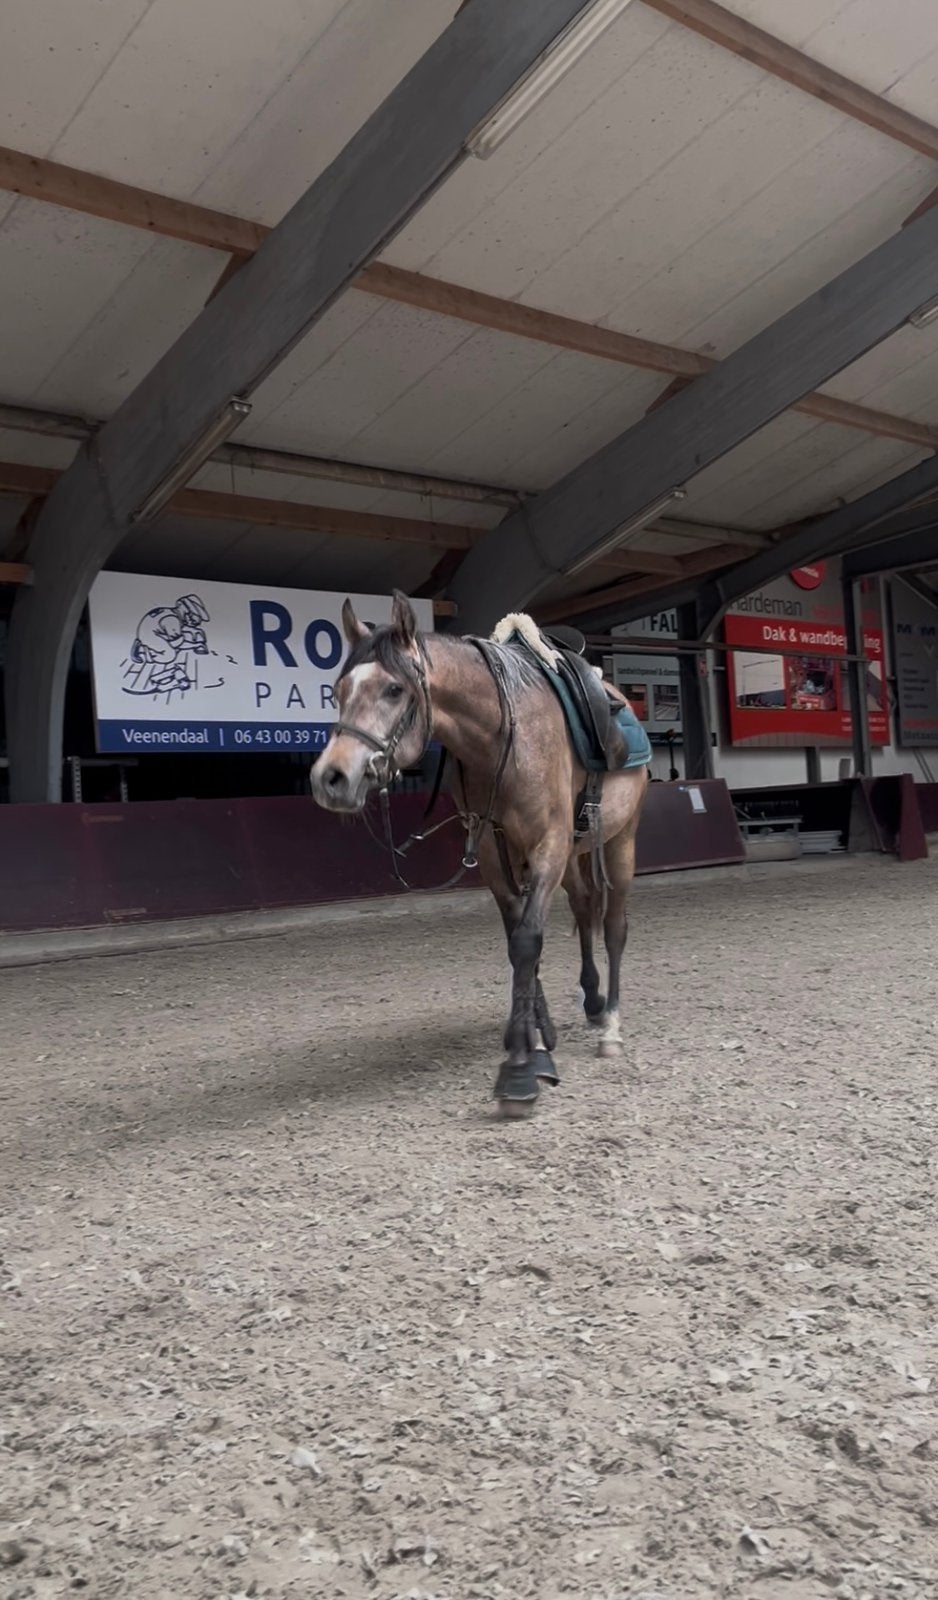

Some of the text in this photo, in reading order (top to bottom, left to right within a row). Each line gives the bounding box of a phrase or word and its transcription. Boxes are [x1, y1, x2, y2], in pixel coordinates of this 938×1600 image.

[763, 626, 787, 642] Dak
[789, 628, 798, 643] &
[122, 728, 209, 744] Veenendaal
[234, 729, 252, 744] 06
[255, 729, 272, 744] 43
[274, 729, 292, 744] 00
[294, 730, 311, 744] 39
[313, 730, 327, 744] 71
